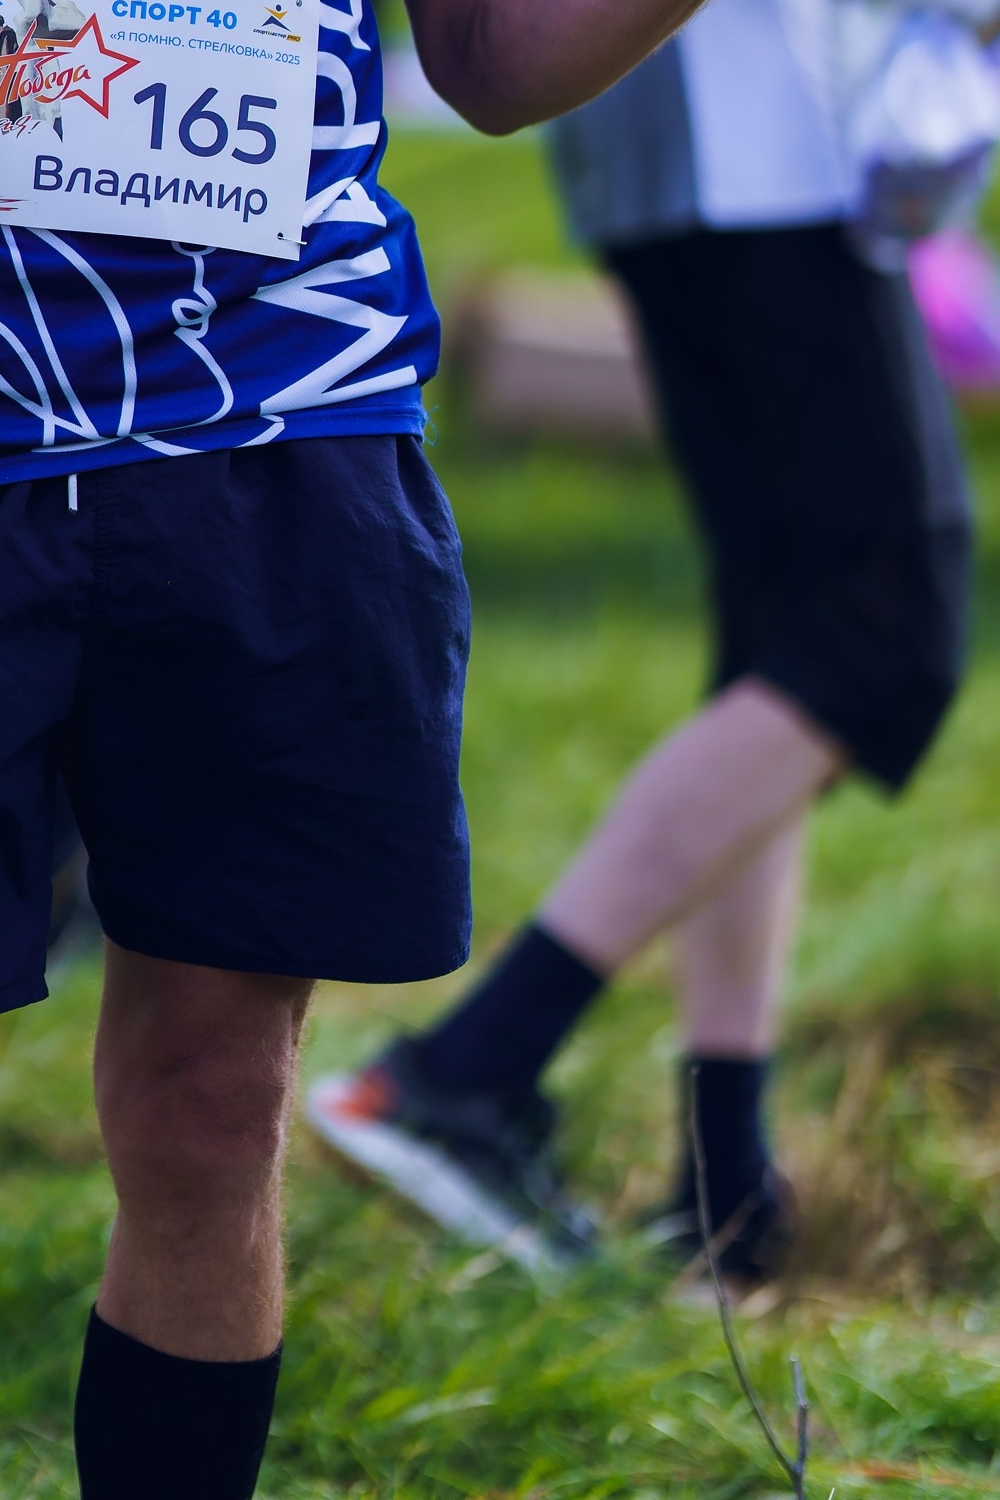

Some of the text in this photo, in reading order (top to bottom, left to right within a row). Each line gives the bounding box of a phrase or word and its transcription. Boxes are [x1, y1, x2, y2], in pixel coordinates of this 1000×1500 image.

[111, 0, 239, 30] СПОРТ 40
[110, 30, 301, 66] «Я ПОМНЮ. СТРЕЛКОВКА» 2025
[133, 82, 278, 165] 165
[33, 154, 268, 223] Владимир
